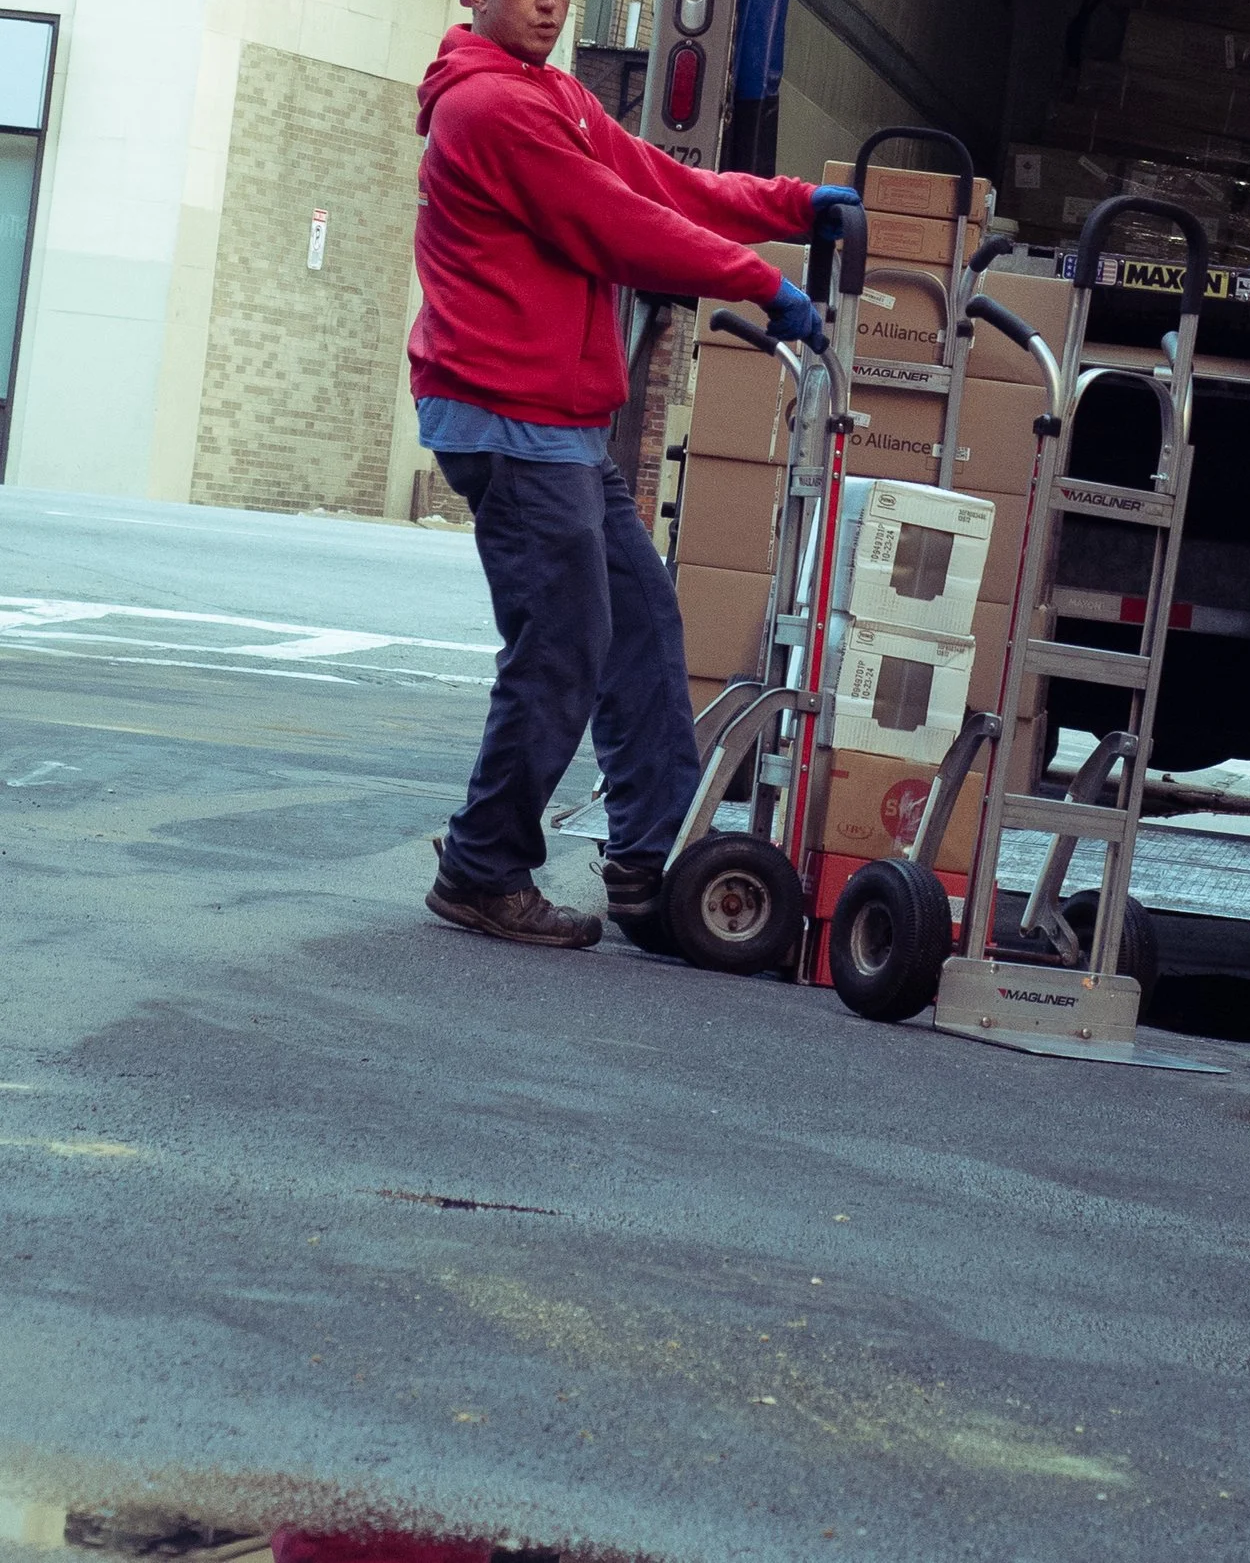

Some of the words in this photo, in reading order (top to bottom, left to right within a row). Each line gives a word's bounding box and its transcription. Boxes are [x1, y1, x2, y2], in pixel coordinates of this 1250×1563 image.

[872, 322, 938, 344] Alliance
[858, 366, 930, 383] MAGLINER
[865, 432, 932, 455] Alliance
[1068, 490, 1141, 512] MAGLINER
[1005, 989, 1076, 1007] MAGLINER
